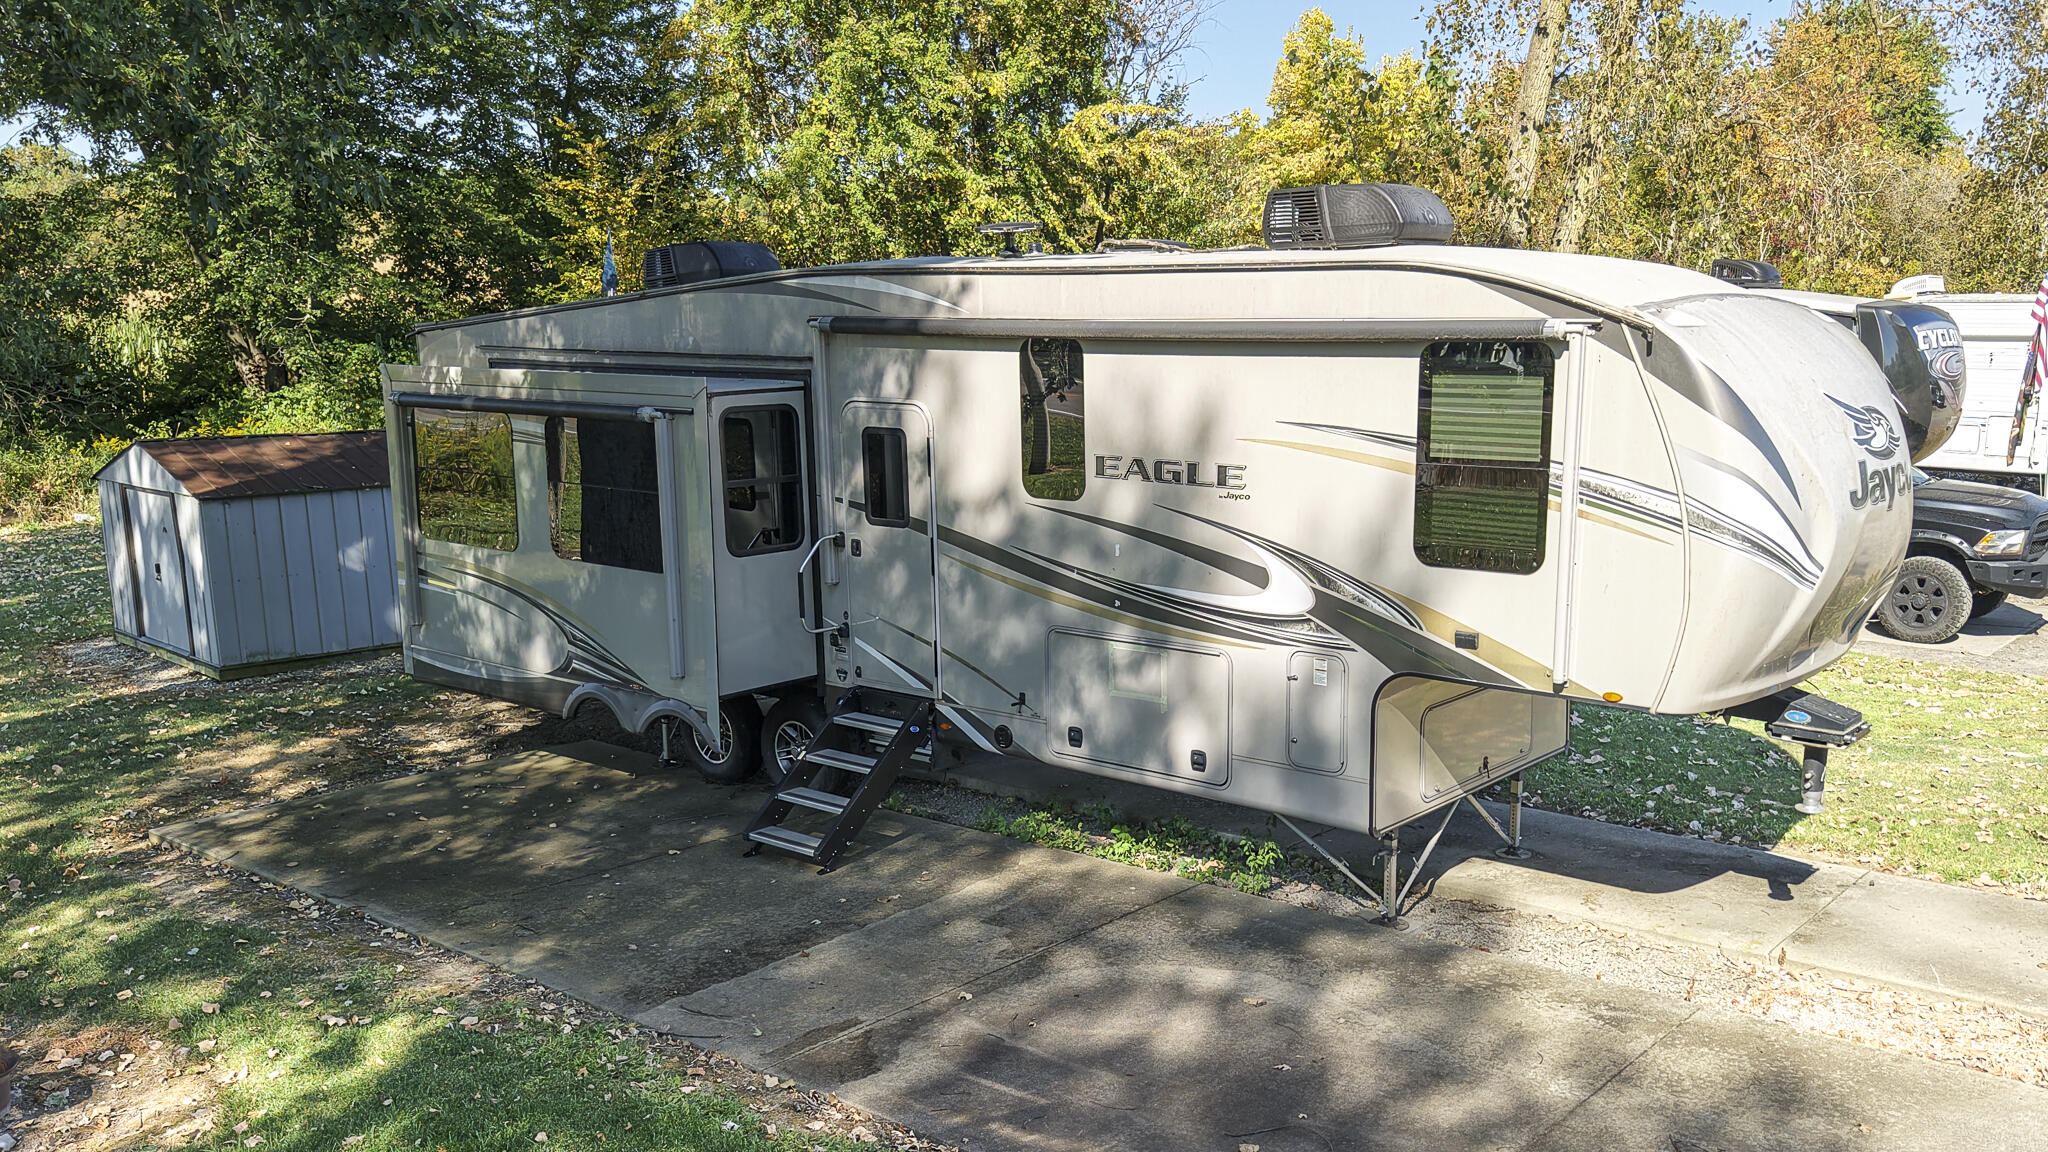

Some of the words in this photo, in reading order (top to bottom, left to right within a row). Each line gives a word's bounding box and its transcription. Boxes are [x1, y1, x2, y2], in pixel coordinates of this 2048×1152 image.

[1917, 328, 1962, 350] CYCLO
[1094, 454, 1247, 490] EAGLE
[1223, 491, 1251, 501] Jayco
